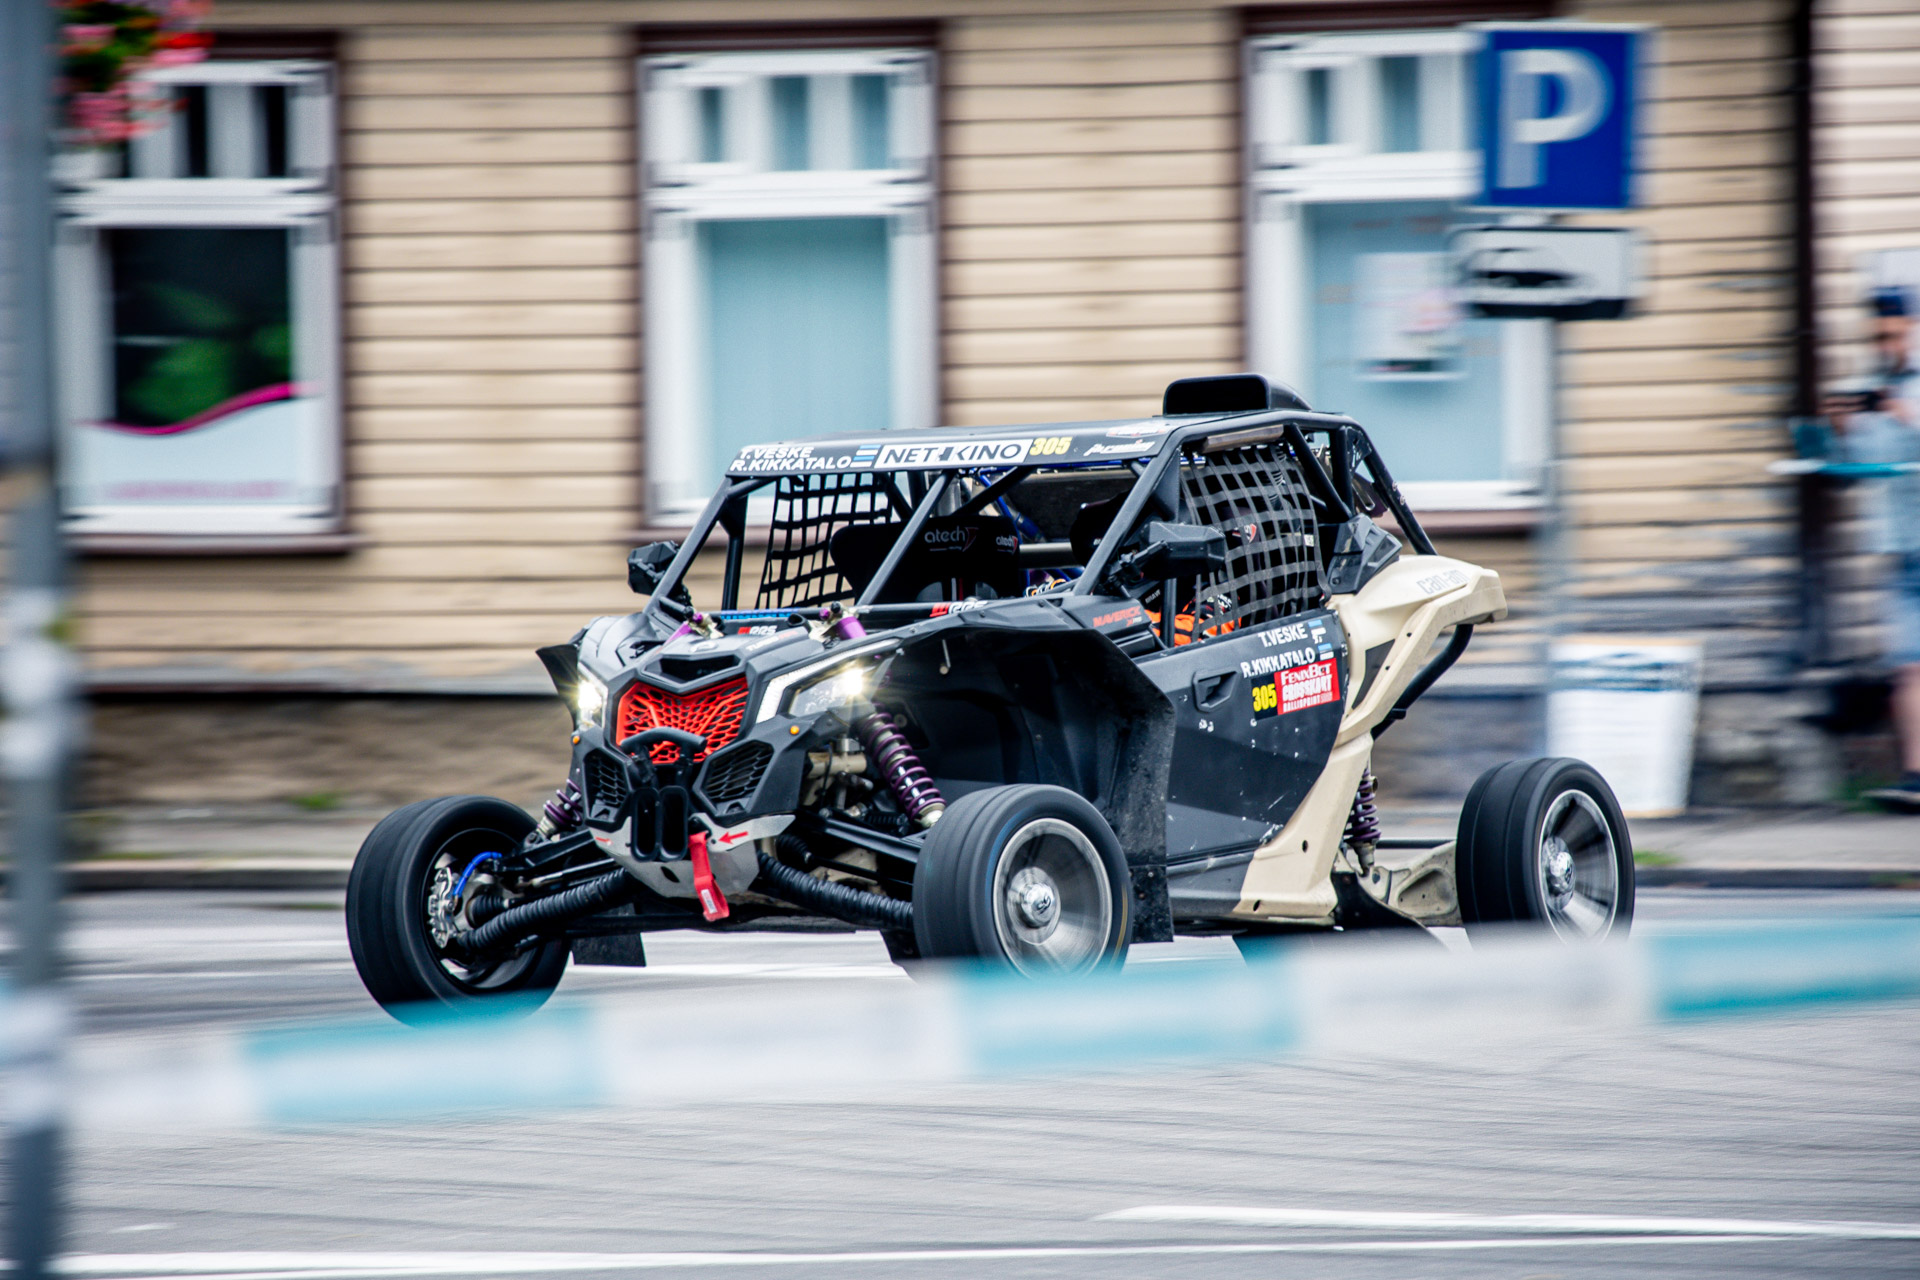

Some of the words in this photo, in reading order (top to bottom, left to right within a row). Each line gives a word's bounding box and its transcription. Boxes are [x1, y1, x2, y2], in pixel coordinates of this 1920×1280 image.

[1497, 49, 1614, 188] P
[729, 456, 852, 472] R.KIKKATALO
[955, 443, 1022, 461] KINO
[1029, 437, 1073, 456] 305
[739, 446, 814, 460] T.VESKE
[1093, 605, 1141, 628] MAVERICK
[1257, 623, 1309, 648] T.VESKE
[1240, 646, 1316, 678] R.KIKKATALO
[1252, 683, 1278, 712] 305
